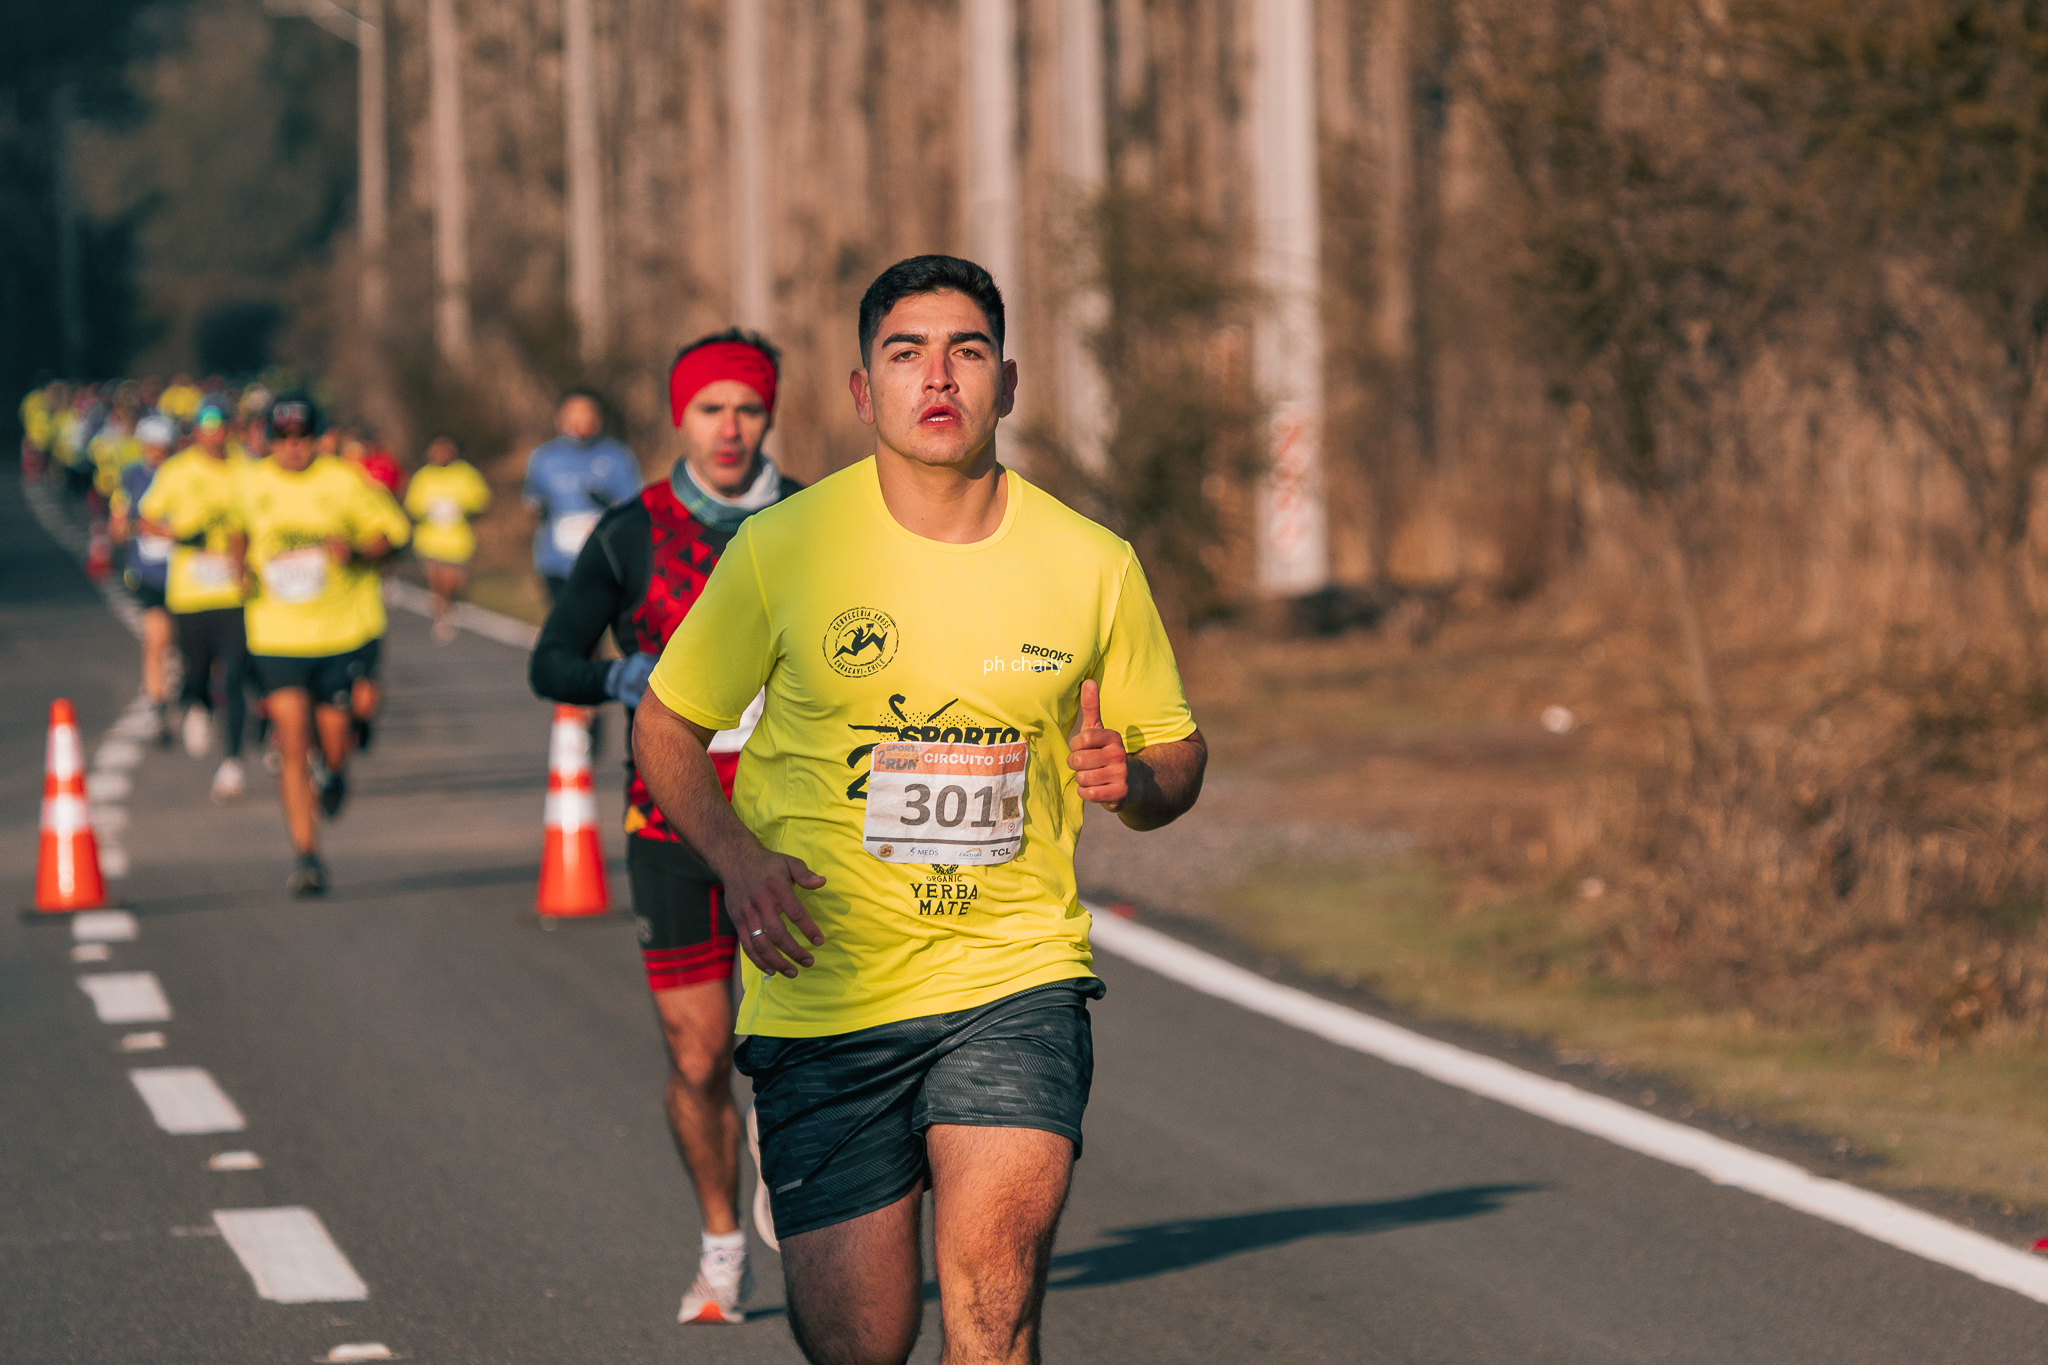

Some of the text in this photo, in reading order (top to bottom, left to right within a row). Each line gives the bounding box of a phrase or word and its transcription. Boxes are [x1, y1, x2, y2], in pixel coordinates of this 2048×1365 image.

[833, 610, 871, 631] CERVECERIA
[1021, 643, 1074, 664] BROOKS
[899, 725, 1021, 745] SPORTO
[886, 744, 923, 753] SPORTO
[885, 758, 919, 771] RUN
[924, 752, 1021, 766] CIRCUITO 10K
[900, 783, 997, 828] 301
[917, 849, 939, 857] MEDS
[990, 847, 1011, 857] TCL
[926, 874, 963, 883] ORGANIC
[910, 882, 979, 900] YERBA
[918, 900, 971, 916] MATE
